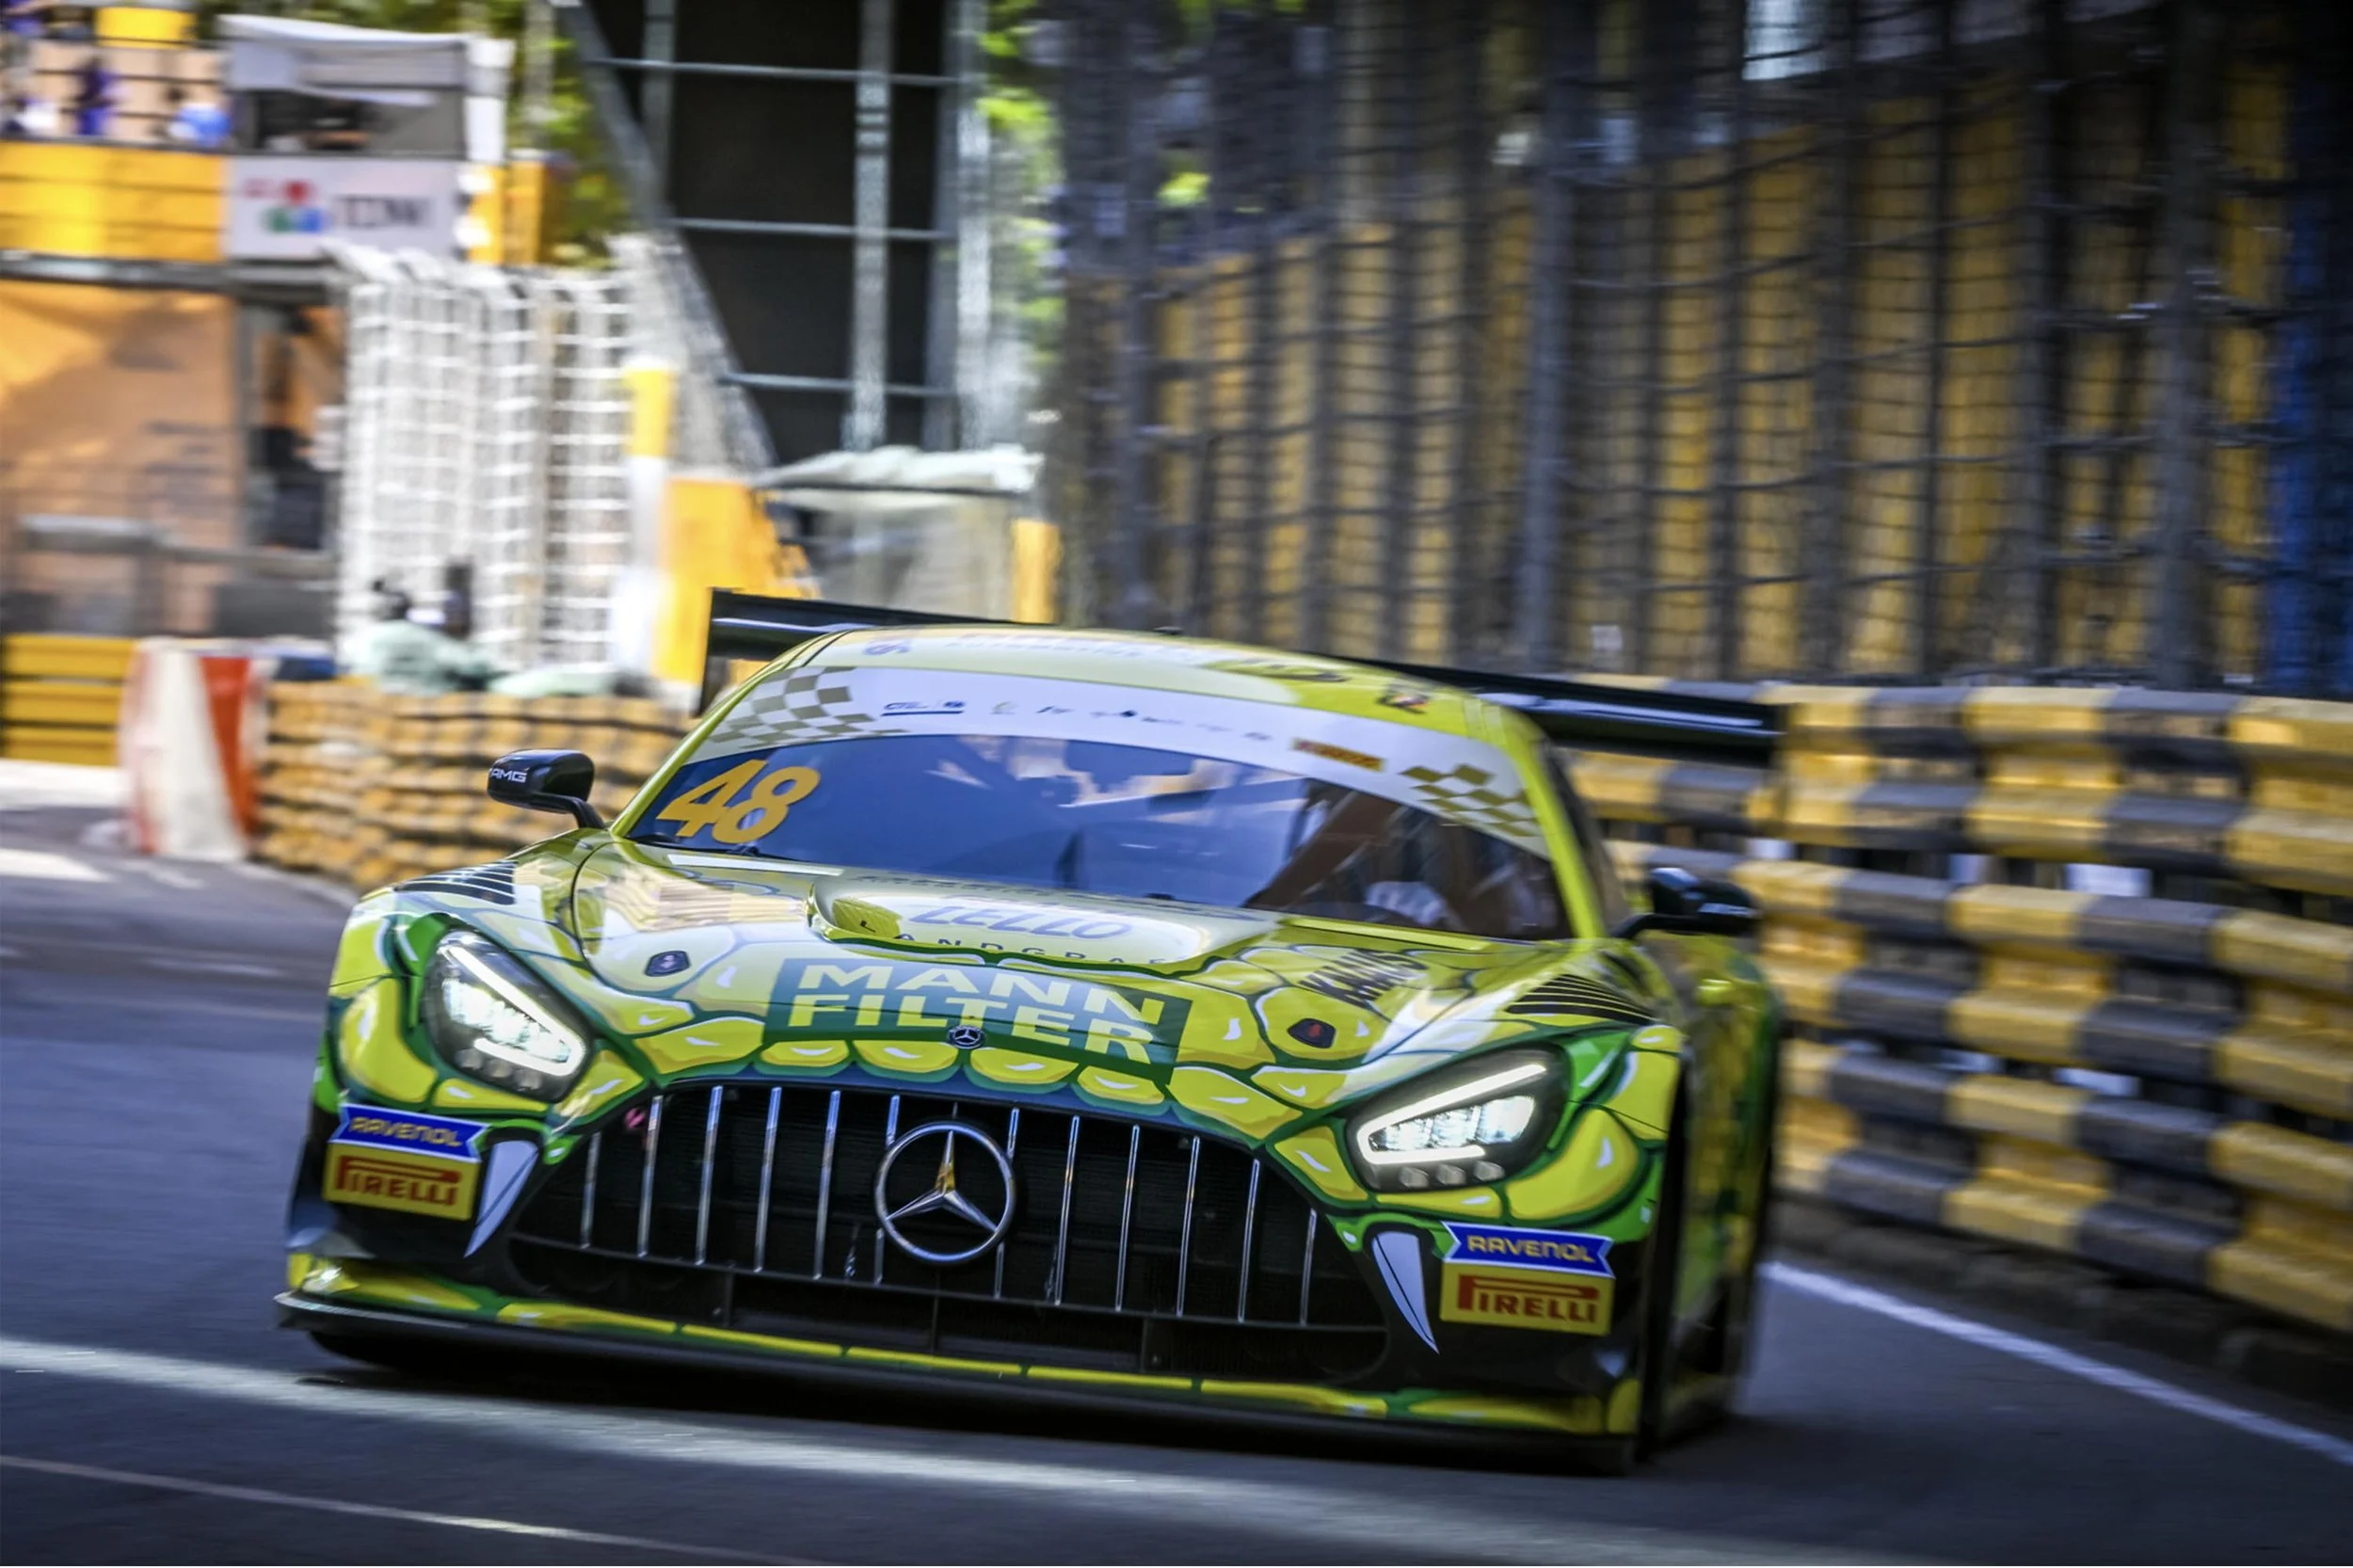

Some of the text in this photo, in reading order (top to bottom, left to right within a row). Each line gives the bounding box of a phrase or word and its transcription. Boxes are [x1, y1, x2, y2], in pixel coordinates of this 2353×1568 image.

[489, 767, 528, 783] AMG
[656, 759, 822, 844] 48
[798, 965, 1165, 1025] MANN
[1299, 947, 1429, 1010] KNAUS
[788, 994, 1156, 1064] FILTER
[350, 1116, 463, 1147] RAVENOL
[335, 1155, 462, 1206] PIRELLI
[1467, 1234, 1596, 1263] RAVENOL
[1456, 1274, 1599, 1323] PIRELLI
